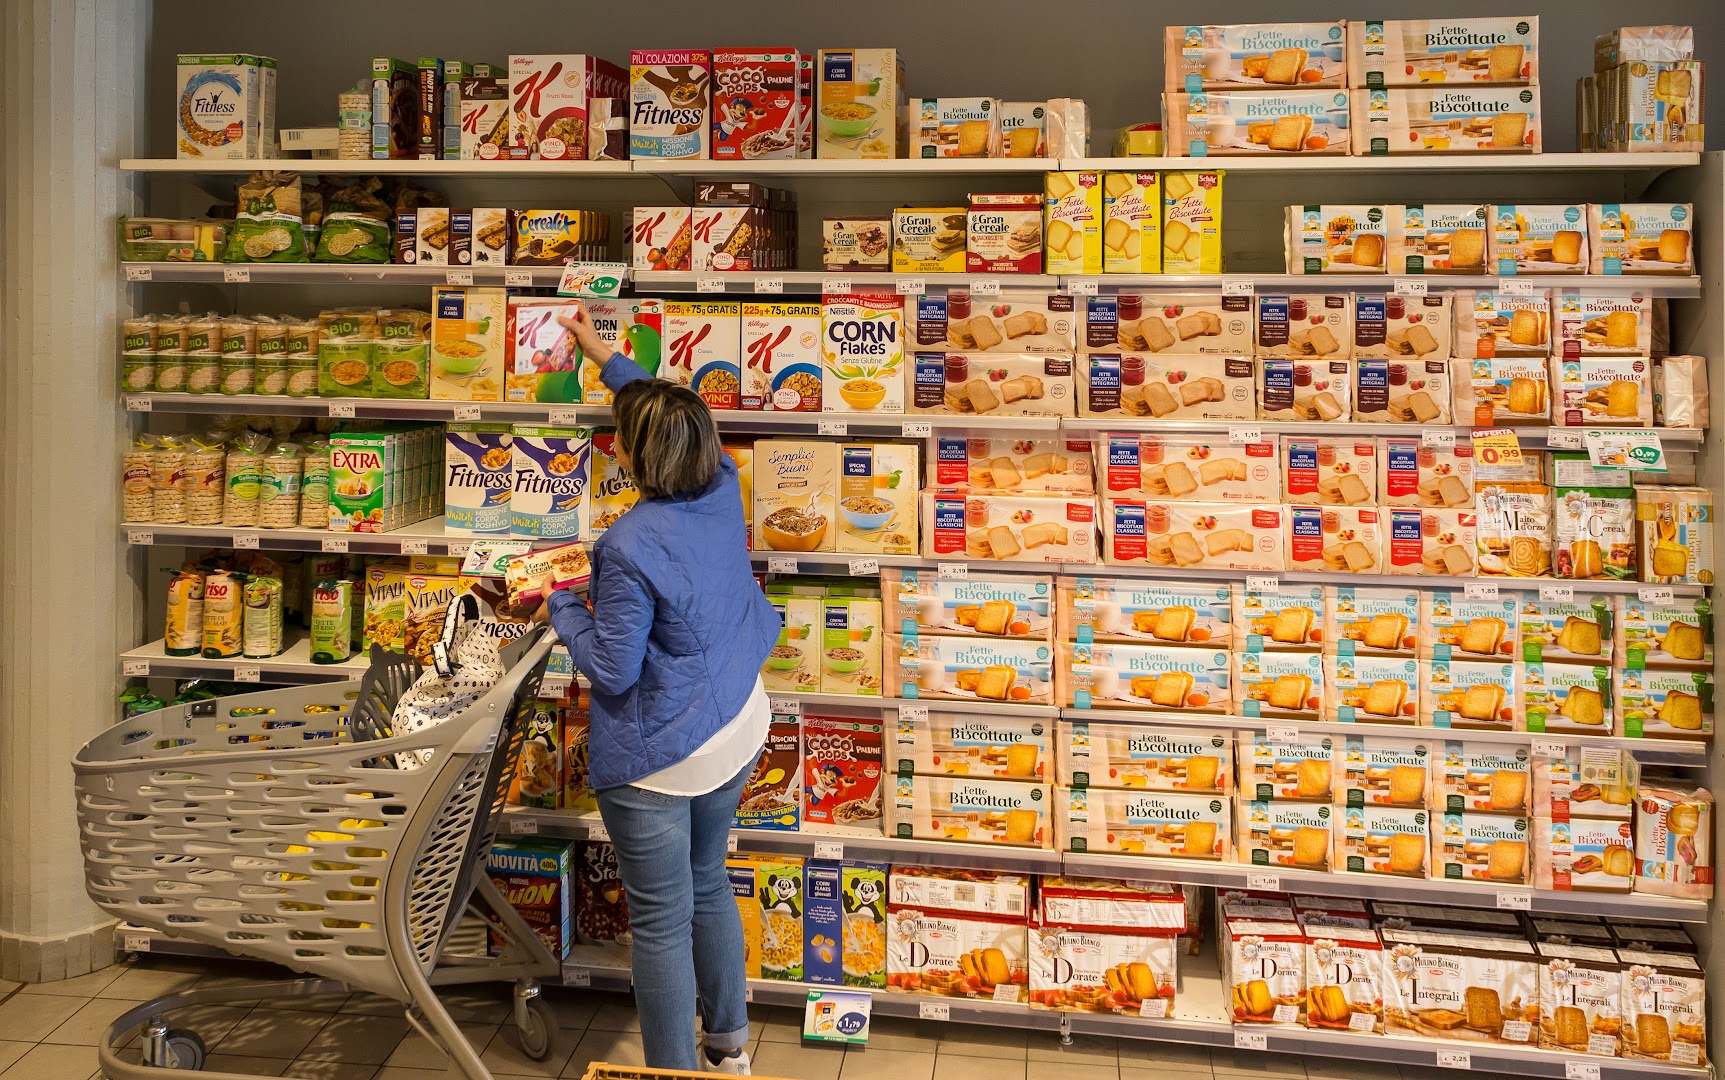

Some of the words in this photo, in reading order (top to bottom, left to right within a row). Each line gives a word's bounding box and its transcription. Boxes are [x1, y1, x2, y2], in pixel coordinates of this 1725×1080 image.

[1257, 31, 1283, 39] Fette
[1441, 26, 1467, 34] Fette
[1242, 37, 1319, 50] Biscottate
[1425, 34, 1505, 46] Biscottate
[632, 53, 644, 64] PIÙ
[645, 54, 689, 63] COLAZIONI
[718, 54, 747, 63] Kellogg's
[718, 72, 763, 86] COCO
[767, 76, 793, 85] PALLINE
[513, 62, 563, 118] K
[727, 84, 759, 97] pops
[1646, 66, 1656, 117] Biscottate
[195, 98, 235, 114] Fitness
[633, 101, 701, 125] Fitness
[943, 112, 989, 120] Biscottate
[662, 135, 694, 144] MISSIONE
[662, 142, 683, 150] CORPO
[1199, 175, 1217, 183] Schär
[1063, 197, 1085, 209] Fette
[1182, 196, 1203, 208] Fette
[1051, 205, 1093, 219] Biscottate
[1170, 206, 1212, 219] Biscottate
[518, 211, 576, 233] Cerealix
[906, 215, 931, 225] Gran
[900, 224, 936, 234] Cereale
[1524, 222, 1578, 231] Biscottate
[596, 280, 612, 289] 1,99
[588, 304, 617, 313] Kellogg's
[707, 305, 738, 314] GRATIS
[788, 306, 819, 315] GRATIS
[1586, 304, 1640, 312] Biscottate
[329, 322, 351, 335] BIO
[829, 321, 895, 342] CORN
[127, 337, 143, 348] BIO
[669, 324, 711, 371] K
[840, 342, 886, 355] flakes
[748, 326, 792, 373] K
[1587, 373, 1641, 381] Biscottate
[515, 428, 538, 436] Nestlé
[1472, 429, 1513, 437] OFFERTA
[769, 449, 815, 464] Semplici
[1484, 449, 1520, 464] 0,99
[1635, 449, 1655, 458] 0,99
[333, 450, 381, 474] EXTRA
[777, 461, 811, 475] Buoni
[448, 464, 512, 490] Fitness
[515, 469, 582, 496] Fitness
[542, 514, 575, 522] MISSIONE
[542, 521, 565, 529] CORPO
[1521, 523, 1545, 531] d'orzo
[1589, 515, 1625, 536] Cereali
[1688, 529, 1696, 582] Biscottate
[525, 565, 555, 575] Cereale
[528, 561, 551, 569] Gran
[206, 584, 227, 596] riso
[968, 581, 992, 591] Fette
[1147, 588, 1171, 596] Fette
[954, 587, 1026, 602] Biscottate
[1132, 594, 1207, 607] Biscottate
[1459, 608, 1513, 619] Biscottate
[1267, 665, 1317, 675] Biscottate
[1650, 681, 1705, 693] Biscottate
[951, 728, 1022, 742] Biscottate
[1143, 735, 1166, 743] Fette
[1128, 740, 1202, 754] Biscottate
[1471, 759, 1525, 770] Biscottate
[964, 786, 987, 796] Fette
[950, 793, 1021, 808] Biscottate
[761, 805, 796, 817] ALL'INTERNO
[1276, 815, 1327, 827] Biscottate
[1470, 829, 1524, 840] Biscottate
[1657, 804, 1667, 856] Biscottate
[1578, 836, 1631, 846] Biscottate
[488, 855, 538, 871] NOVITÀ
[510, 883, 556, 903] LION
[916, 919, 935, 932] MULINO
[937, 920, 956, 932] BIANCO
[1058, 935, 1078, 947] MULINO
[1080, 937, 1100, 948] BIANCO
[909, 942, 953, 967] Dorate
[1257, 944, 1274, 953] MULINO
[1276, 944, 1291, 953] BIANCO
[1260, 958, 1296, 978] Dorate
[1415, 957, 1437, 968] MULINO
[1438, 958, 1459, 969] BIANCO
[1051, 962, 1098, 985] Dorate
[1649, 976, 1667, 986] MULINO
[1668, 979, 1686, 989] BIANCO
[1400, 989, 1409, 997] Le
[1412, 980, 1459, 1004] Integrali
[1655, 992, 1693, 1013] Integrali
[844, 1017, 860, 1029] 1,79
